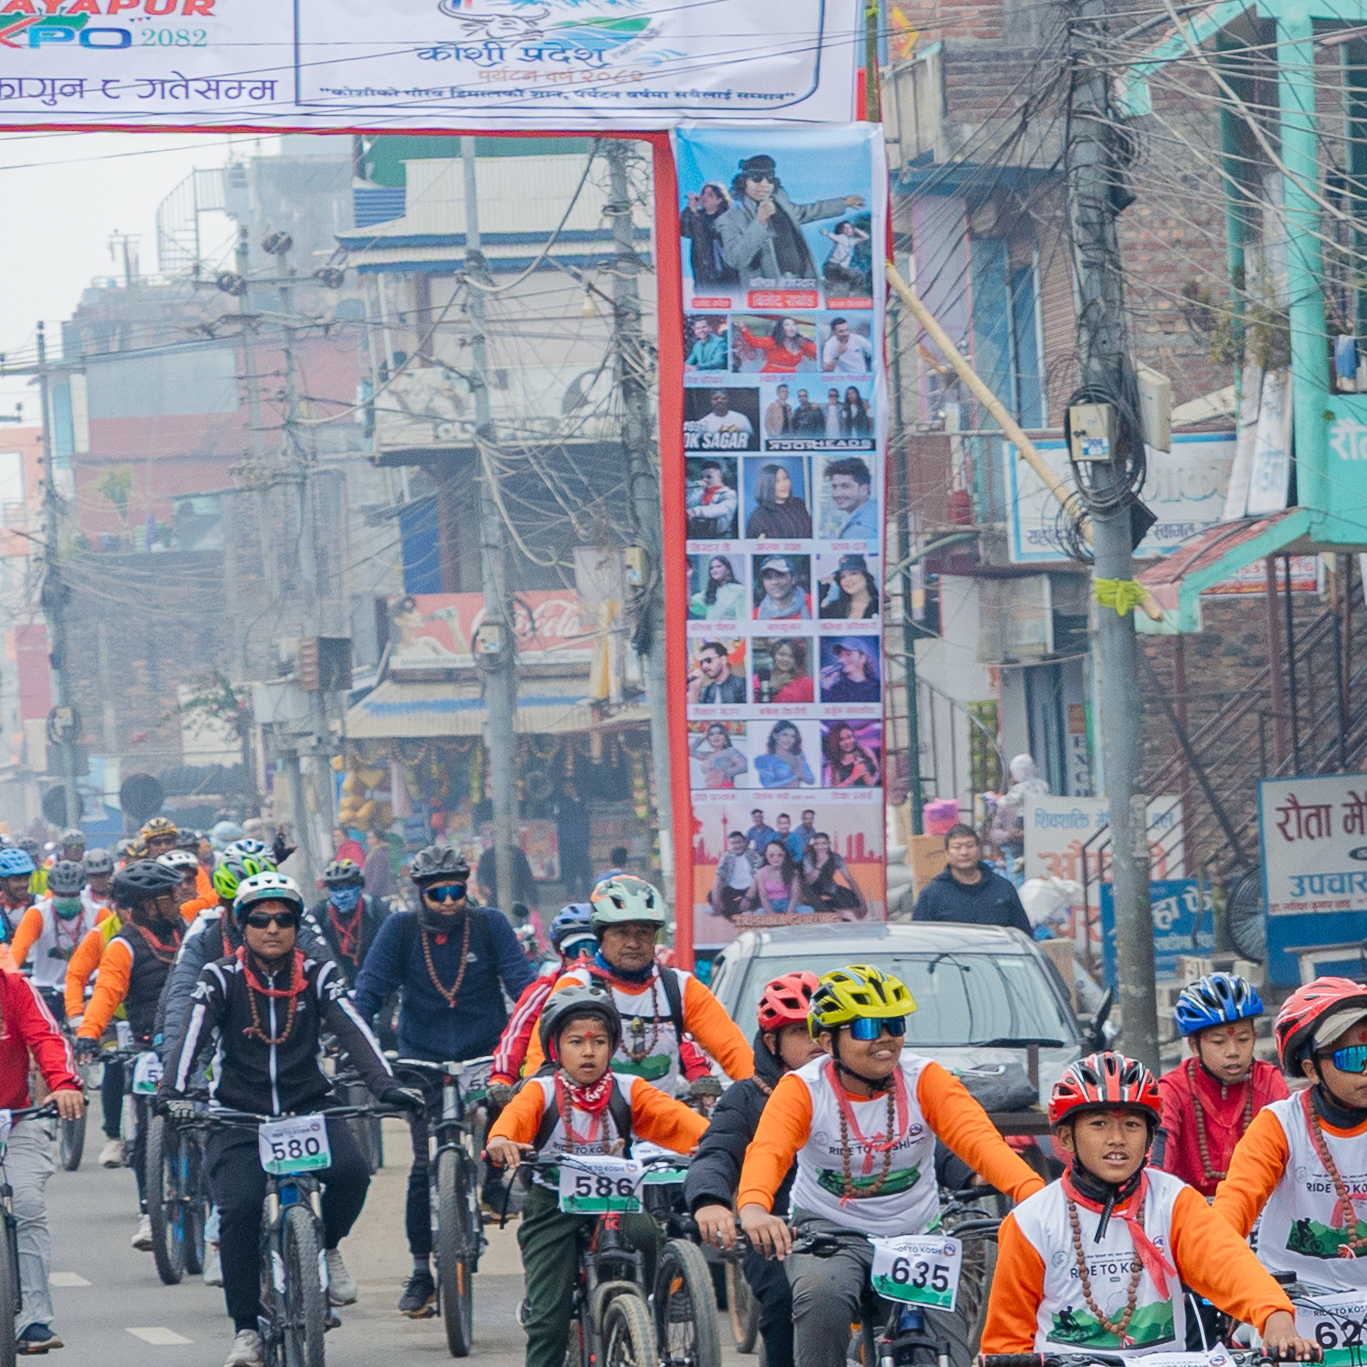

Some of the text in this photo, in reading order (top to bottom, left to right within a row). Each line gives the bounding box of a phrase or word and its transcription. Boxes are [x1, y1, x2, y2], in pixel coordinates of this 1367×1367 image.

[142, 28, 207, 48] 2082
[417, 41, 613, 68] कोशी प्रदेश
[702, 431, 749, 450] SAGAR
[1275, 793, 1332, 842] रौता
[272, 1137, 320, 1161] 580
[575, 1176, 634, 1198] 586
[1306, 1182, 1331, 1194] RIDE
[891, 1257, 949, 1293] 635
[1100, 1265, 1115, 1276] TO
[1335, 1306, 1347, 1315] TO
